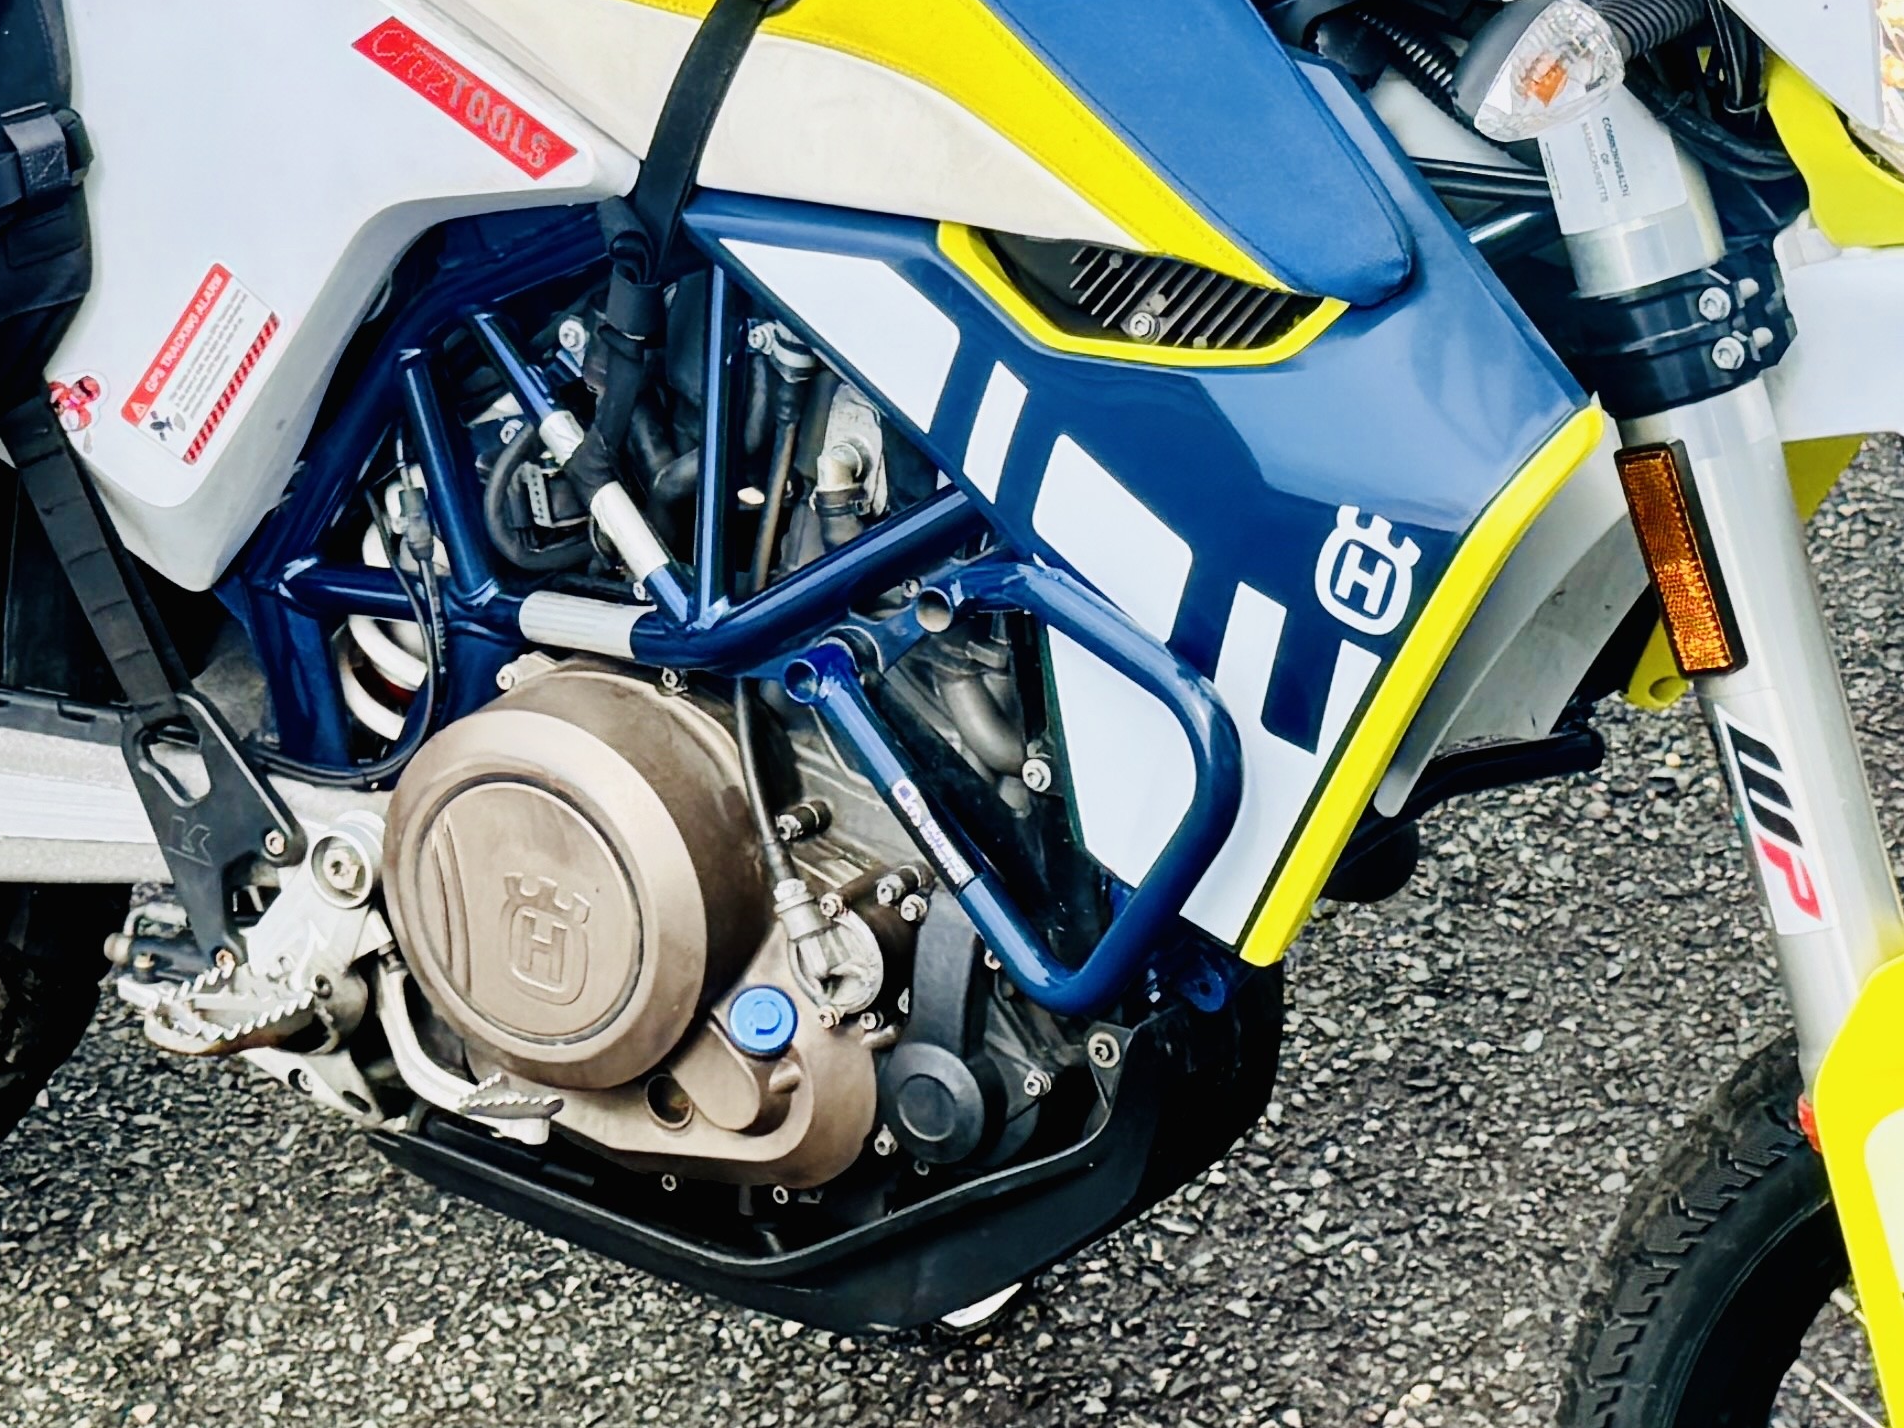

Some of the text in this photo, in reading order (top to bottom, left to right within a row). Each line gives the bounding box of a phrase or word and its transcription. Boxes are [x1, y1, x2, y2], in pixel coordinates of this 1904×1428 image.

[143, 272, 225, 394] GPS TRACKING ALARM
[1725, 722, 1823, 921] WP
